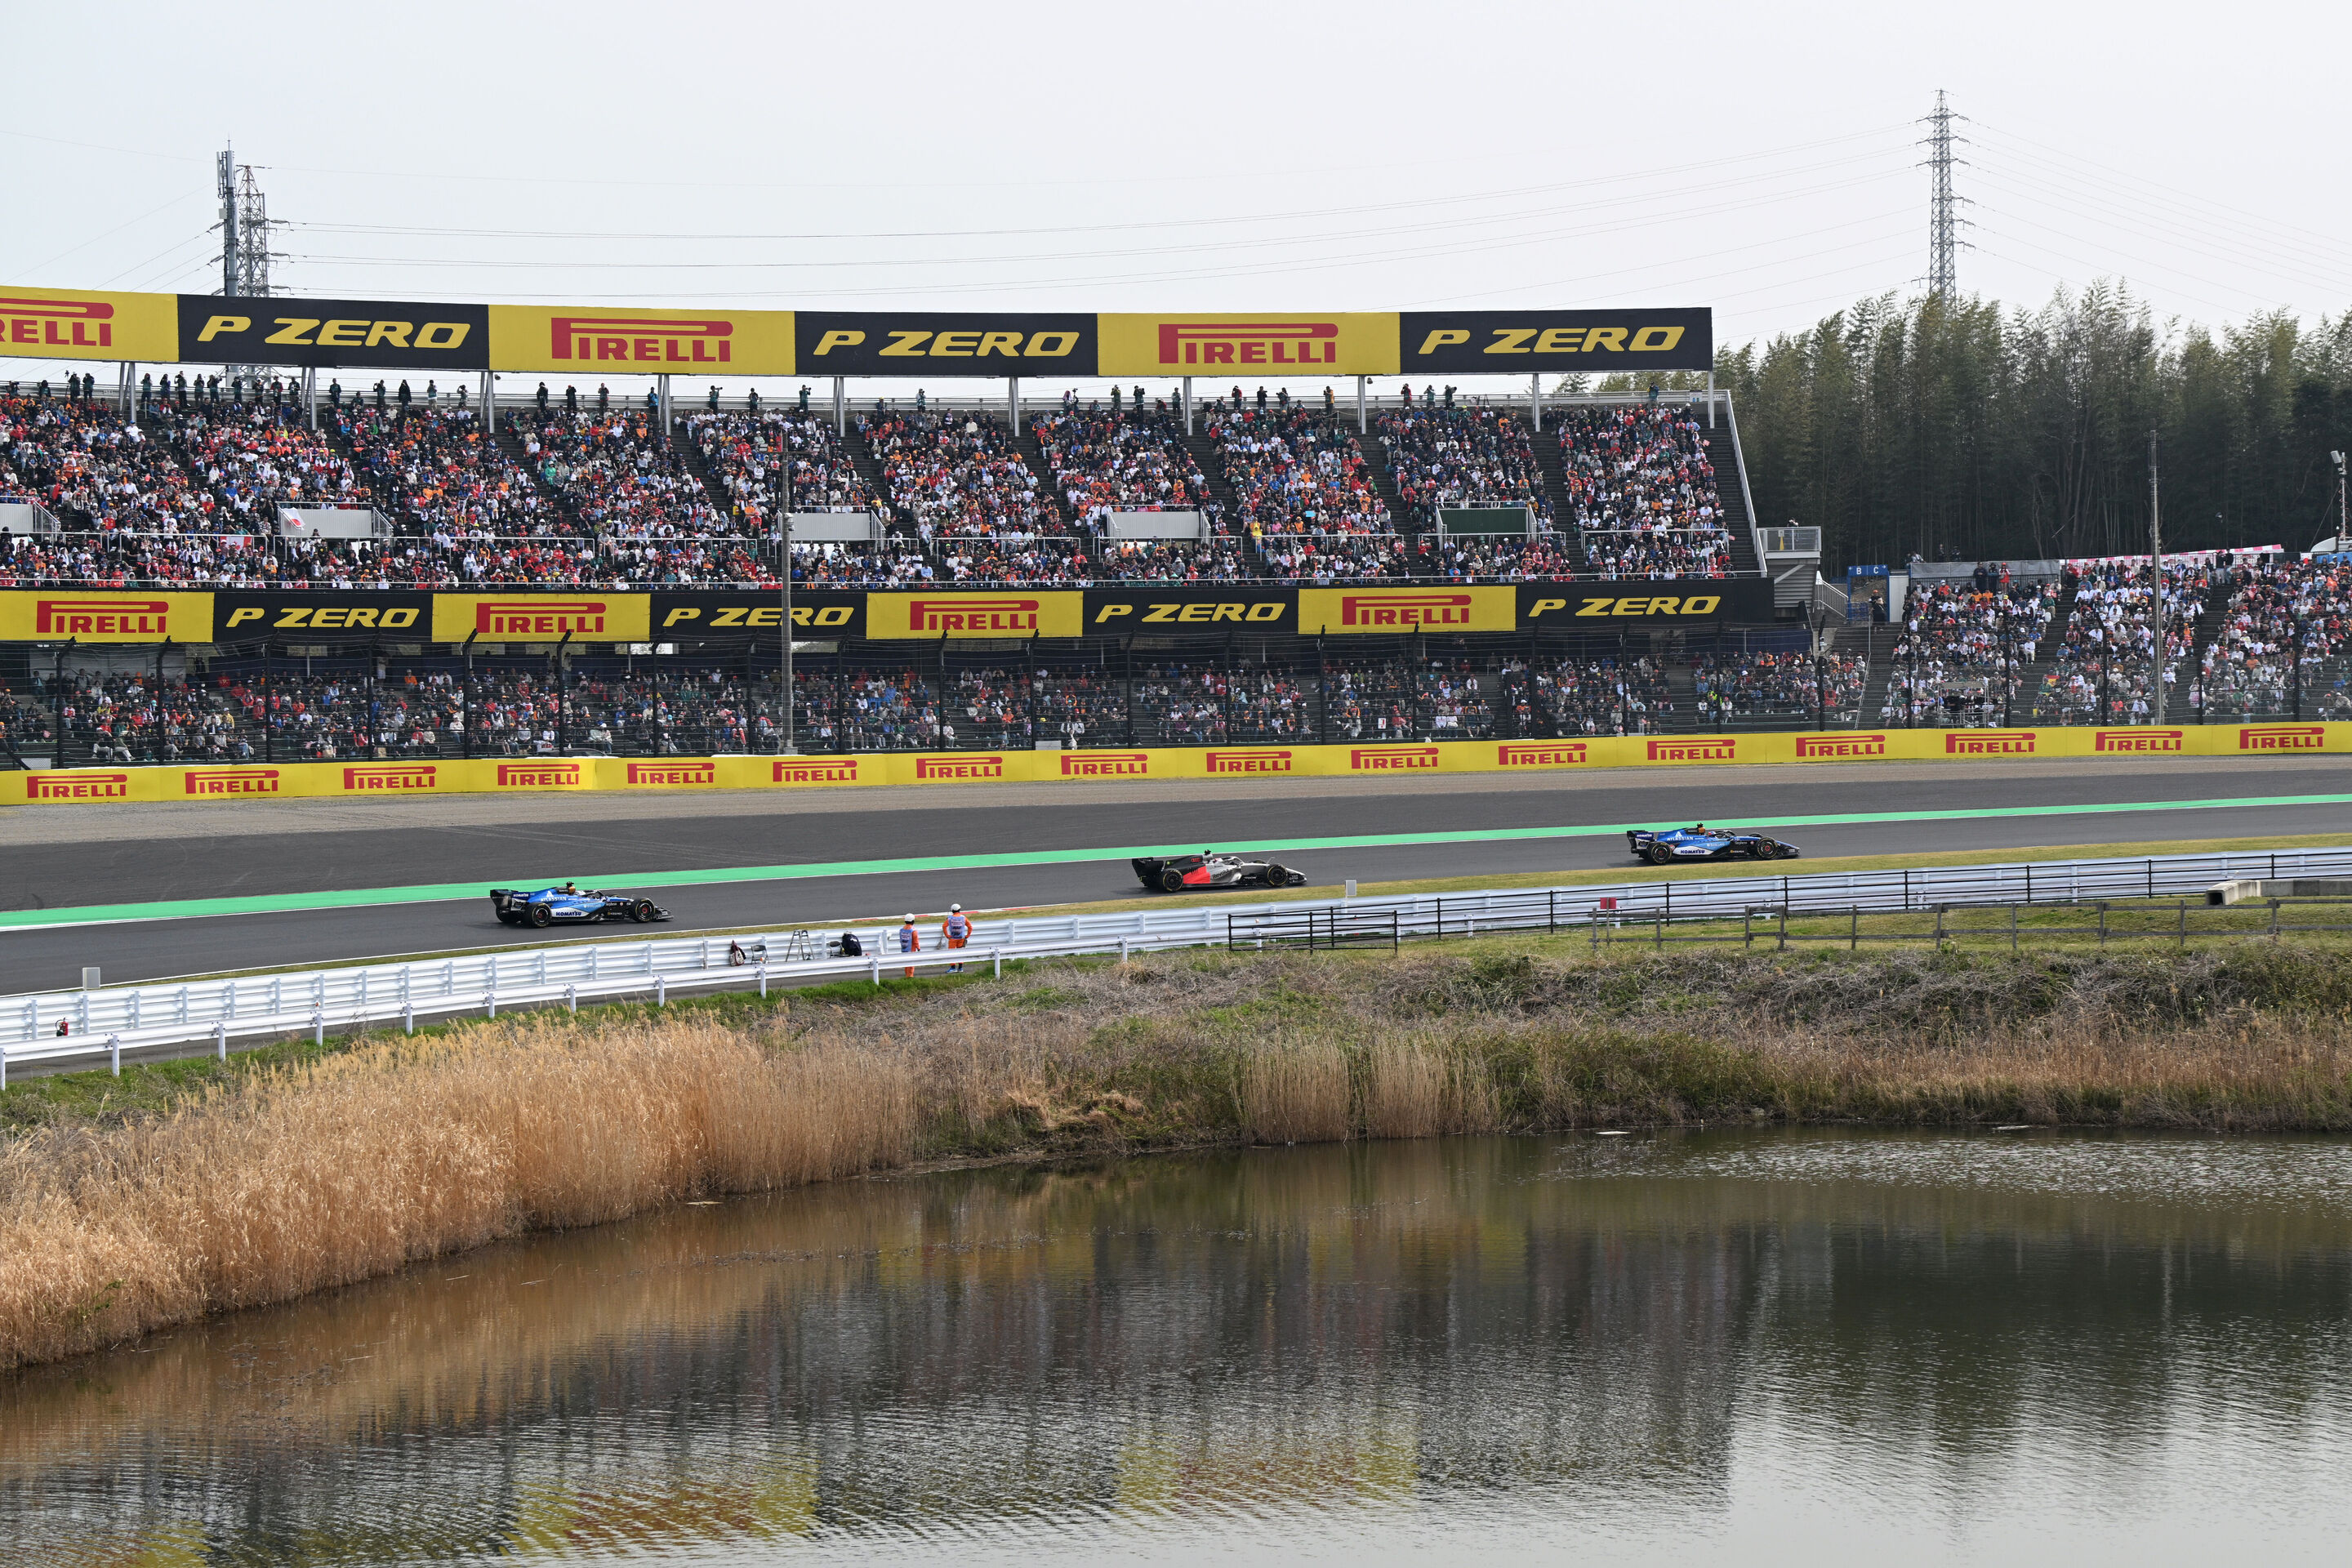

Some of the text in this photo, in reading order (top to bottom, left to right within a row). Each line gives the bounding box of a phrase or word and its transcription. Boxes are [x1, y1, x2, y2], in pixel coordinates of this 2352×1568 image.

[198, 316, 470, 348] P ZERO
[551, 318, 733, 362] PIRELLI
[1419, 327, 1685, 354] P ZERO
[813, 331, 1080, 356] P ZERO
[1159, 323, 1338, 363] PIRELLI
[1856, 566, 1879, 575] B C
[37, 601, 168, 633] PIRELLI
[663, 608, 853, 626] P ZERO
[911, 600, 1039, 630] PIRELLI
[1095, 604, 1285, 622] P ZERO
[1343, 595, 1471, 625] PIRELLI
[1529, 596, 1721, 617] P ZERO
[226, 608, 419, 627] P ZERO
[477, 603, 606, 633] PIRELLI
[1797, 735, 1885, 756] PIRELLI
[1947, 733, 2036, 753] PIRELLI
[2096, 731, 2182, 751] PIRELLI
[2241, 728, 2324, 749] PIRELLI
[1352, 748, 1438, 768] PIRELLI
[1499, 744, 1587, 764] PIRELLI
[1648, 740, 1735, 760] PIRELLI
[773, 760, 857, 782] PIRELLI
[917, 757, 1002, 778] PIRELLI
[1062, 755, 1147, 774] PIRELLI
[1207, 751, 1292, 772] PIRELLI
[186, 770, 279, 793] PIRELLI
[345, 767, 436, 789] PIRELLI
[498, 764, 579, 785] PIRELLI
[628, 764, 715, 783] PIRELLI
[28, 775, 127, 797] PIRELLI
